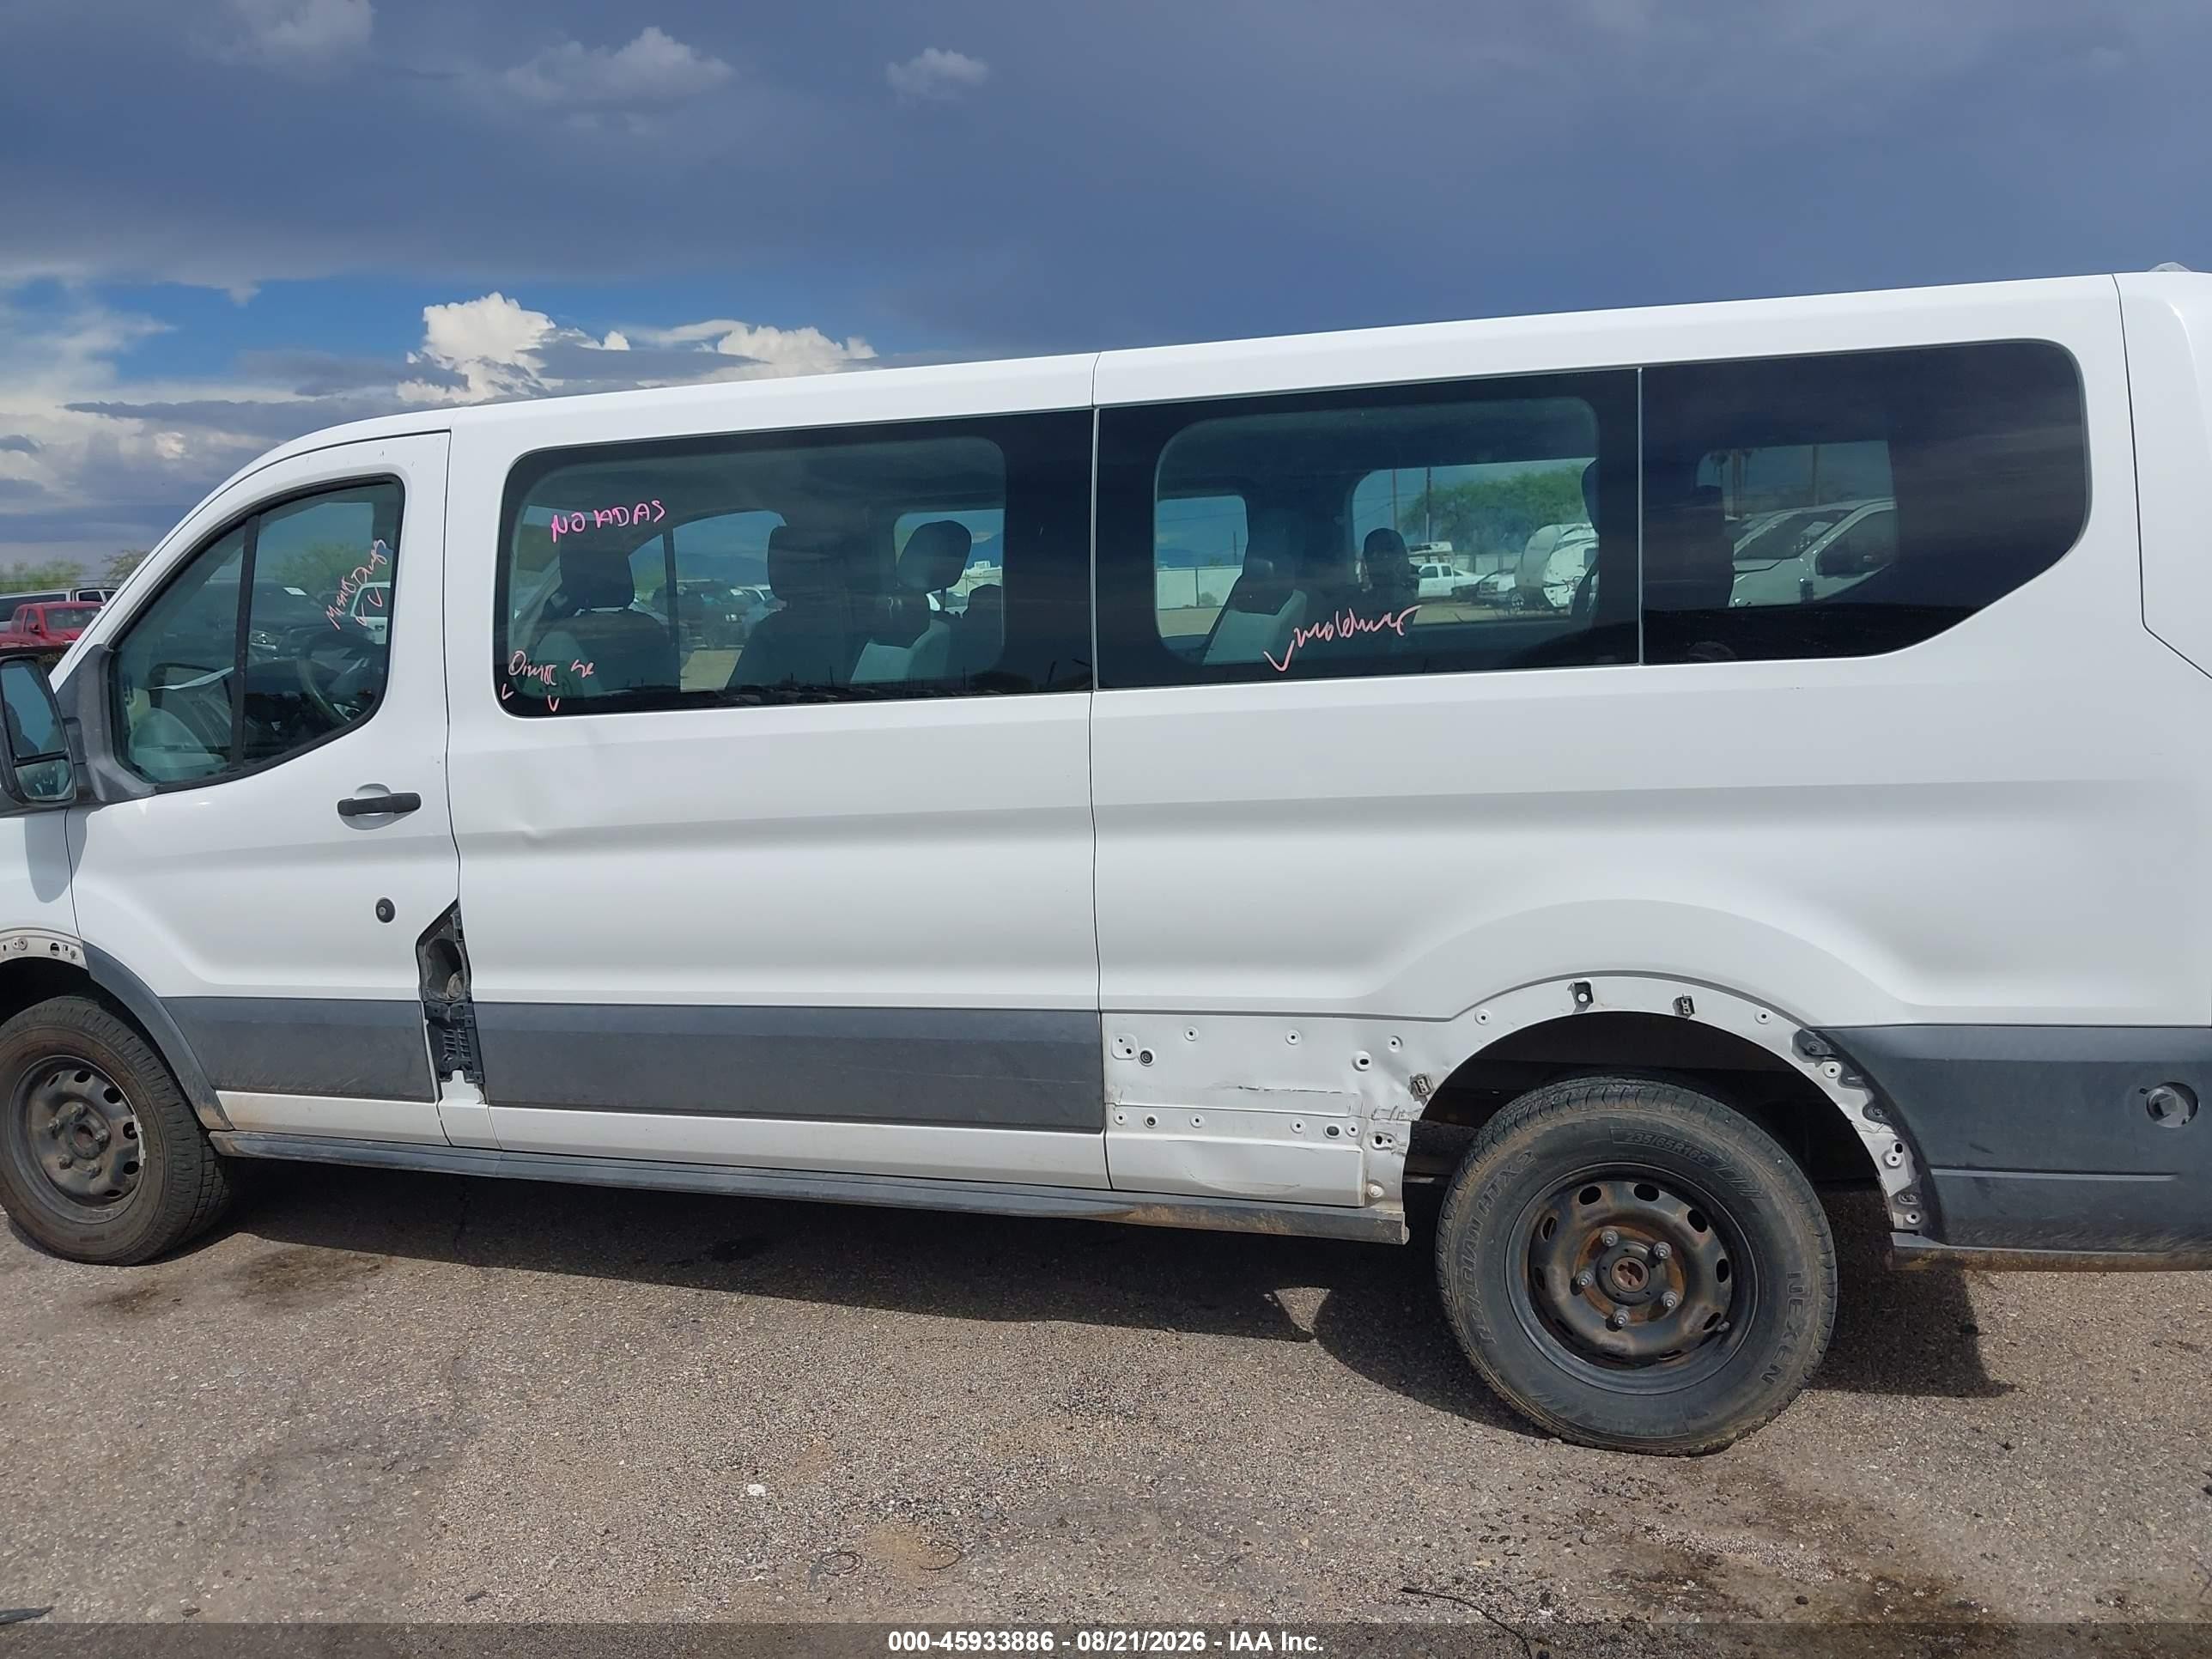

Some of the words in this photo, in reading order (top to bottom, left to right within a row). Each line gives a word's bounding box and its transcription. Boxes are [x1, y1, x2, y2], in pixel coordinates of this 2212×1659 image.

[550, 512, 586, 544] NO
[593, 499, 665, 529] ADAS
[1760, 1270, 1806, 1386] NEXEN
